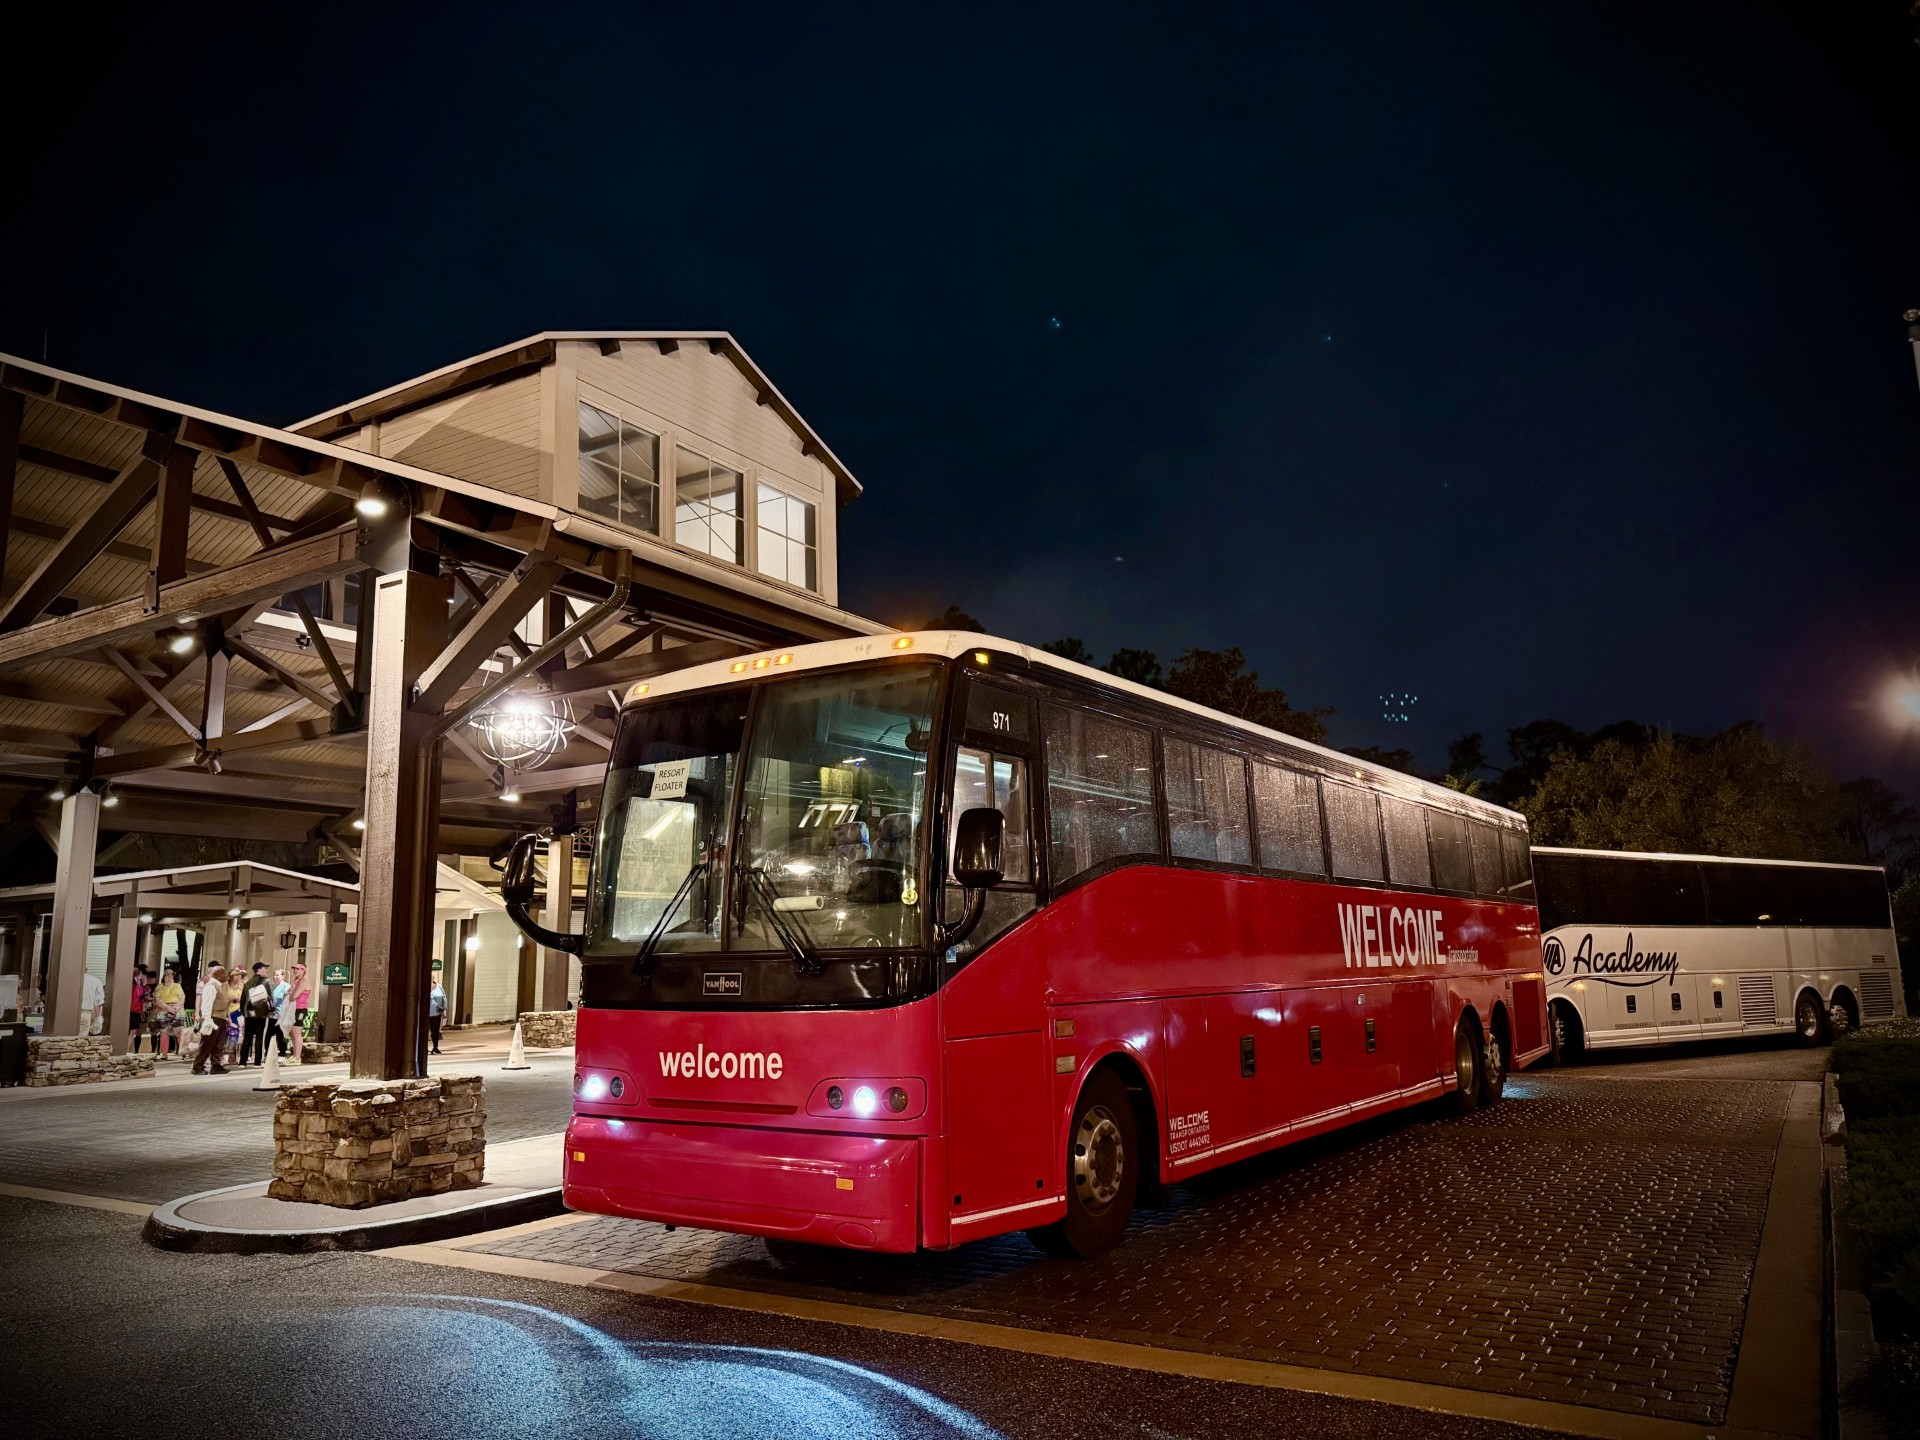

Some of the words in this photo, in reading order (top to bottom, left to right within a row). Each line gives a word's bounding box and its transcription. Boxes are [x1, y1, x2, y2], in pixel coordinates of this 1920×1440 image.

[993, 711, 1010, 731] 971
[658, 768, 685, 778] RESORT
[654, 781, 683, 792] FLOATER
[1337, 902, 1447, 968] WELCOME
[1573, 932, 1679, 986] Academy
[659, 1043, 783, 1080] welcome
[1169, 1110, 1209, 1131] WELCOME
[1170, 1124, 1210, 1140] TRANSPORTATION
[1170, 1140, 1188, 1154] USDOT
